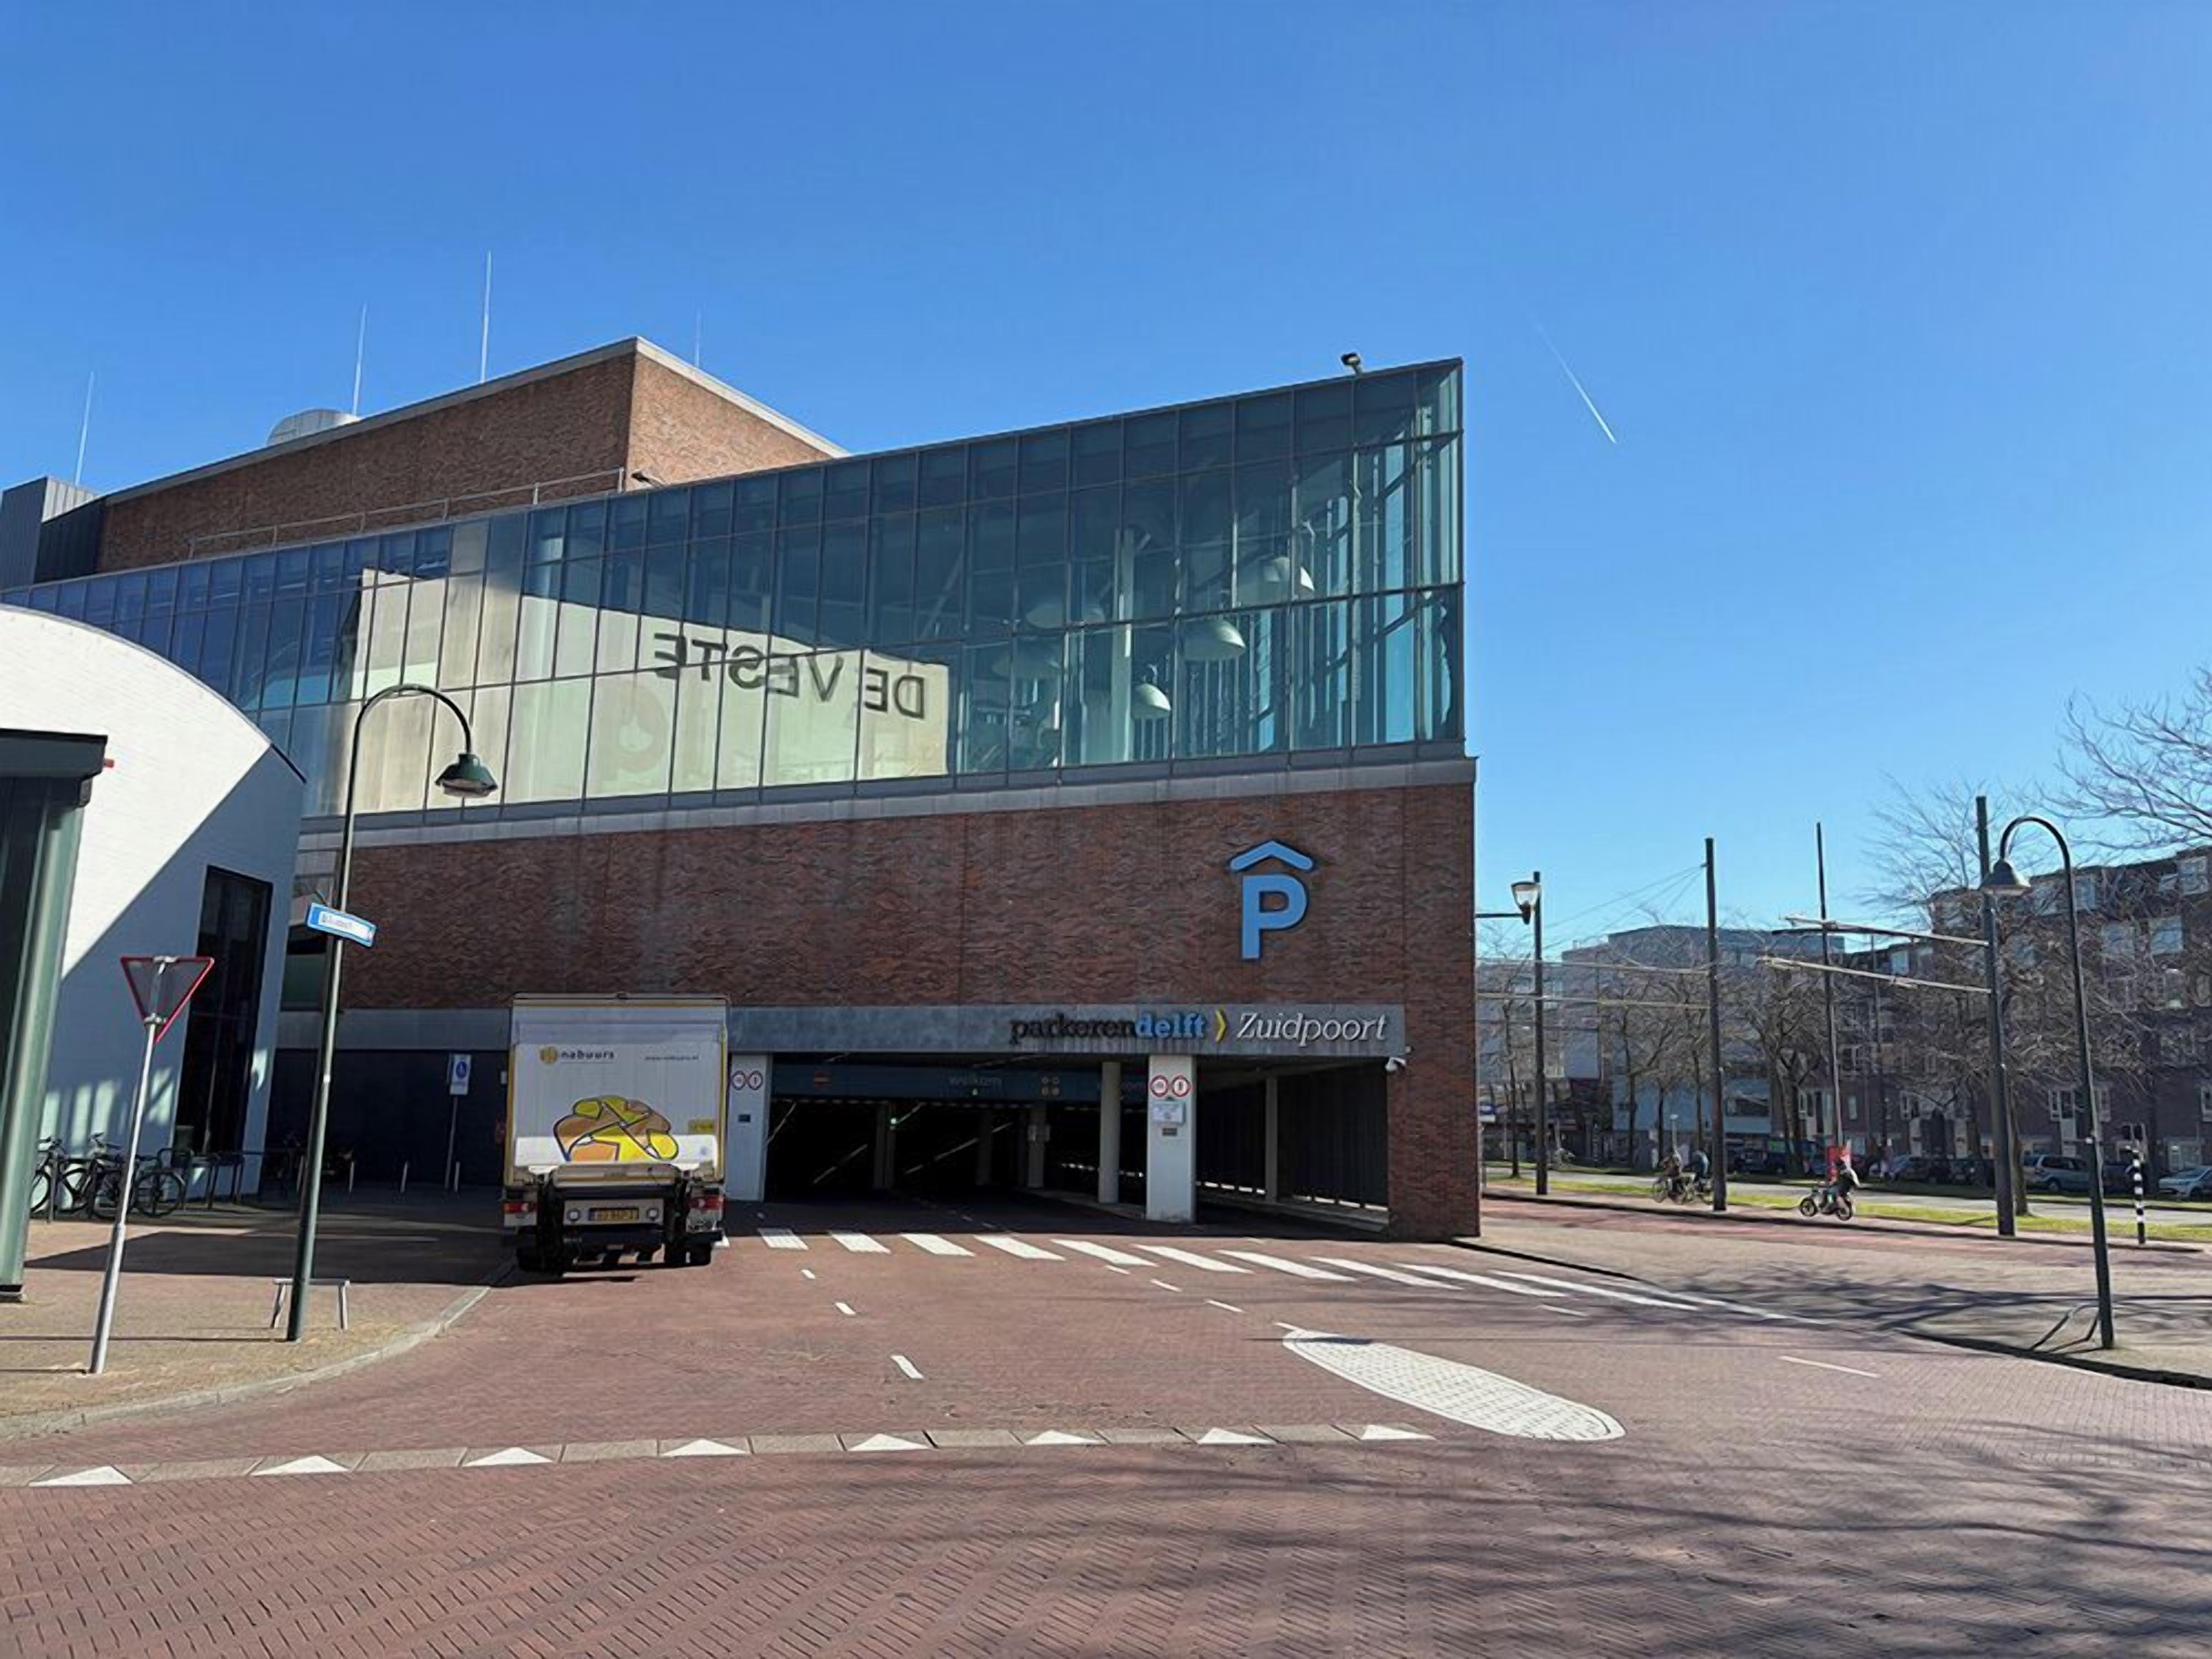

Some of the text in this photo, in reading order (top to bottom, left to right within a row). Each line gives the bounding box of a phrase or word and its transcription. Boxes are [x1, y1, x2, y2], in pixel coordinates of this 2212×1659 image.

[1242, 874, 1308, 959] P
[1237, 1011, 1387, 1047] Zuidpoort
[561, 1050, 614, 1060] nabuurs
